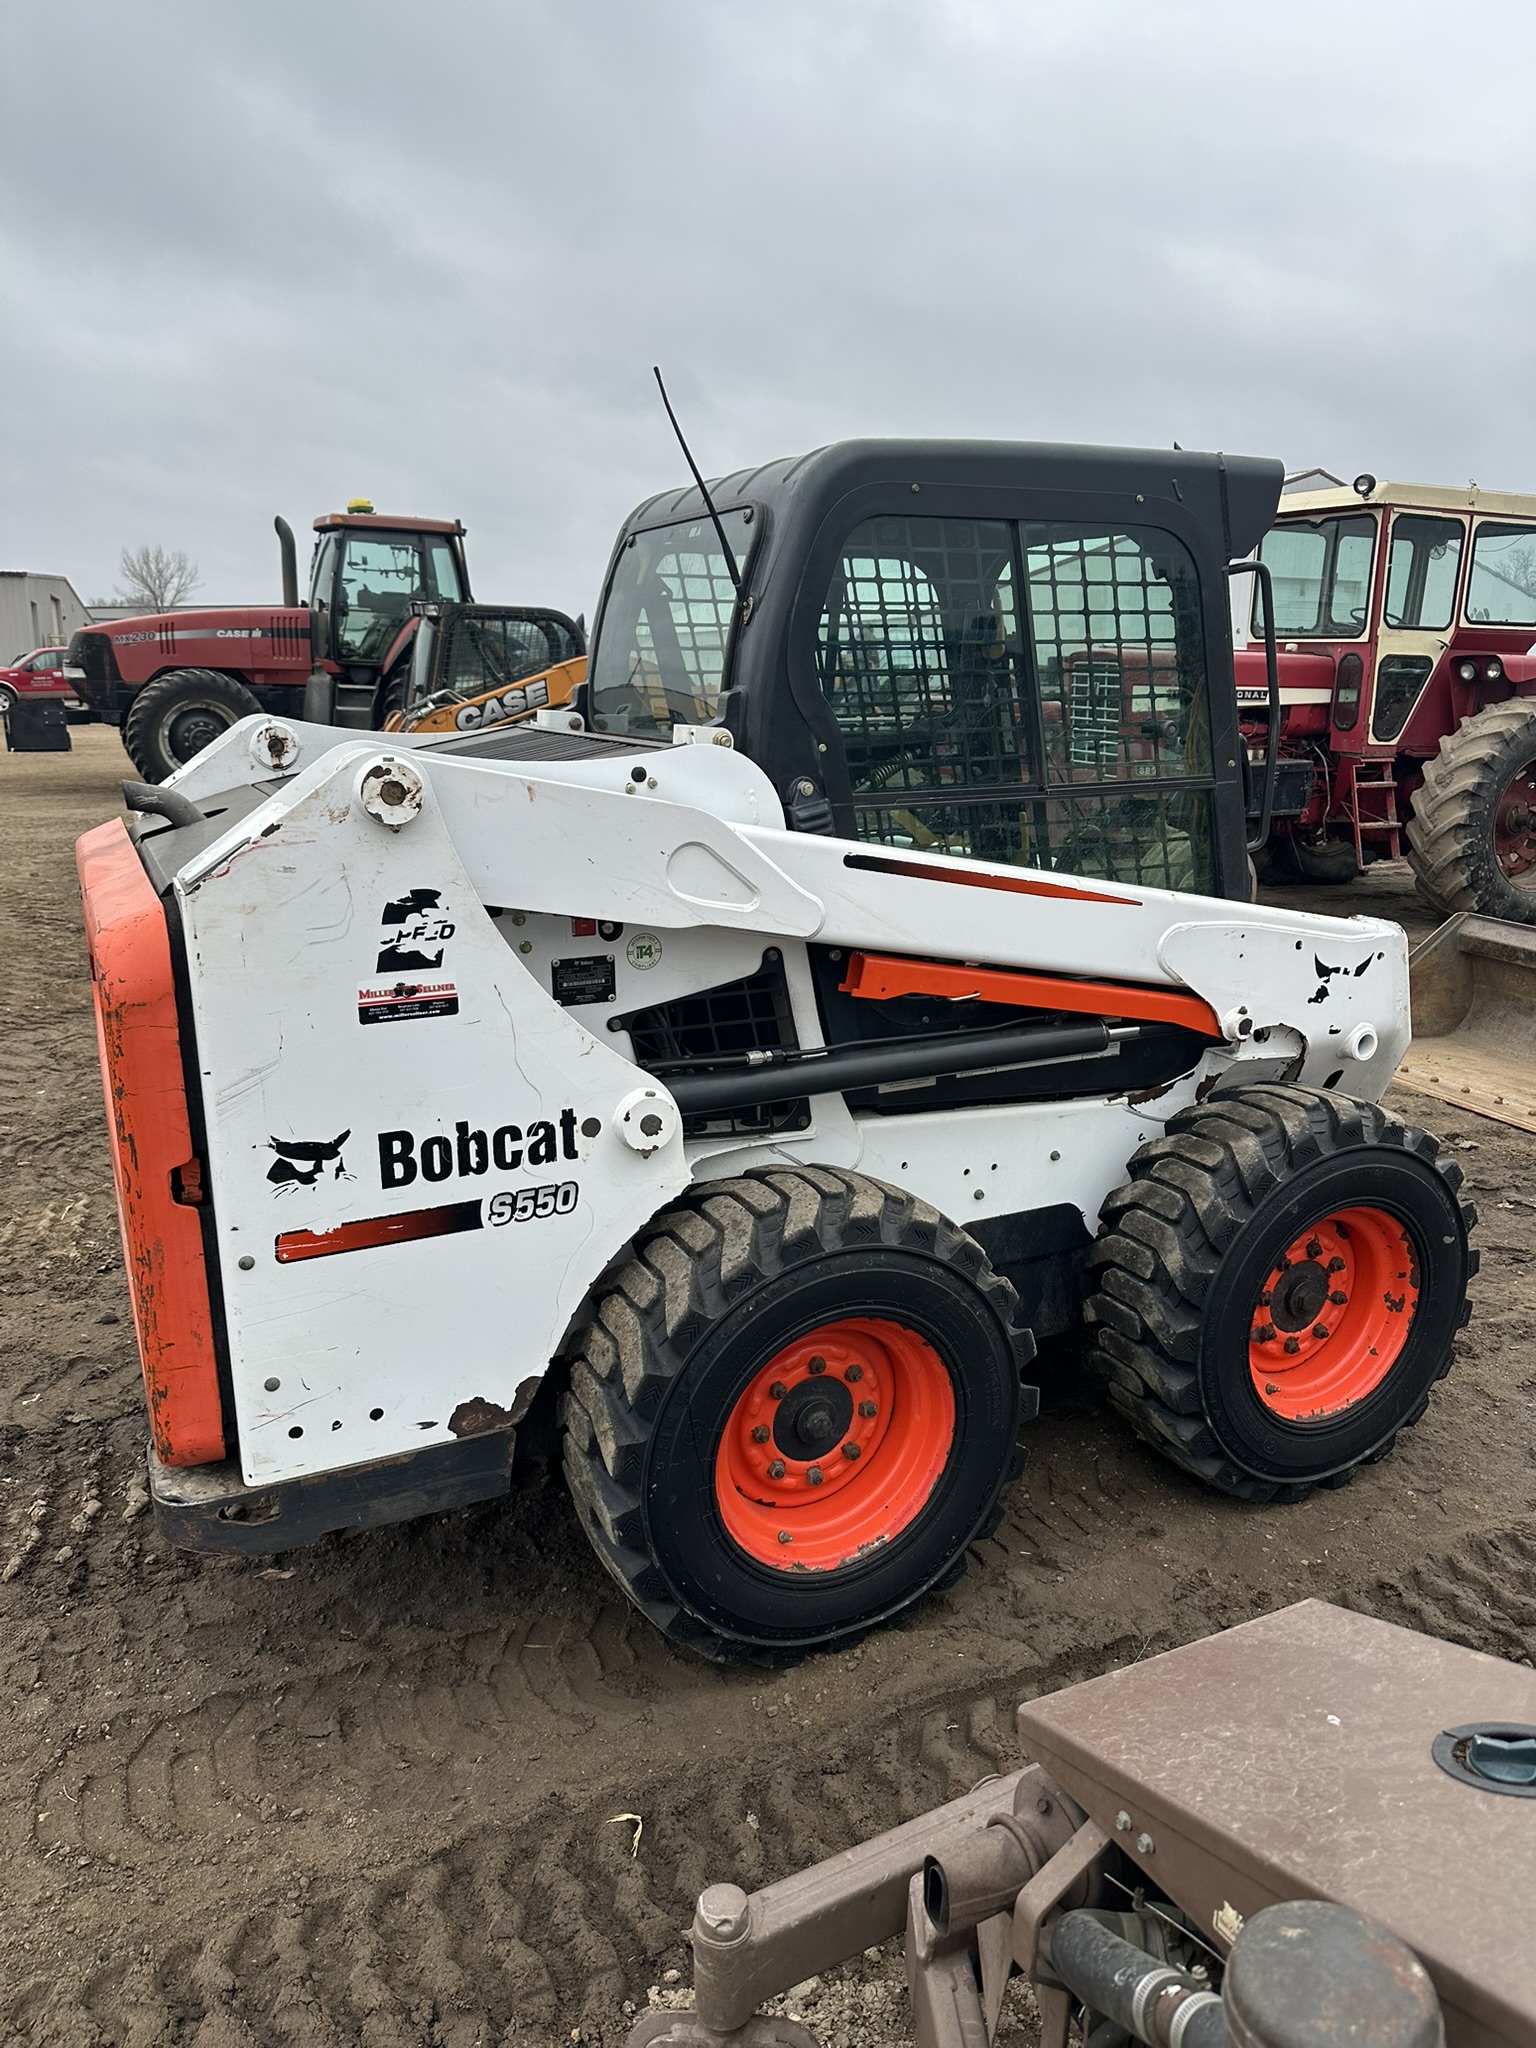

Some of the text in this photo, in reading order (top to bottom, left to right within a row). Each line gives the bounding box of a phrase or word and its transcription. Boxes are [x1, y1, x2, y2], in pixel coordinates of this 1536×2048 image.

[115, 631, 157, 644] MX230
[216, 630, 249, 638] CASE
[456, 678, 549, 731] CASE
[358, 983, 456, 999] MILLER SELLNER
[378, 1108, 579, 1190] Bobcat
[488, 1181, 580, 1227] S550
